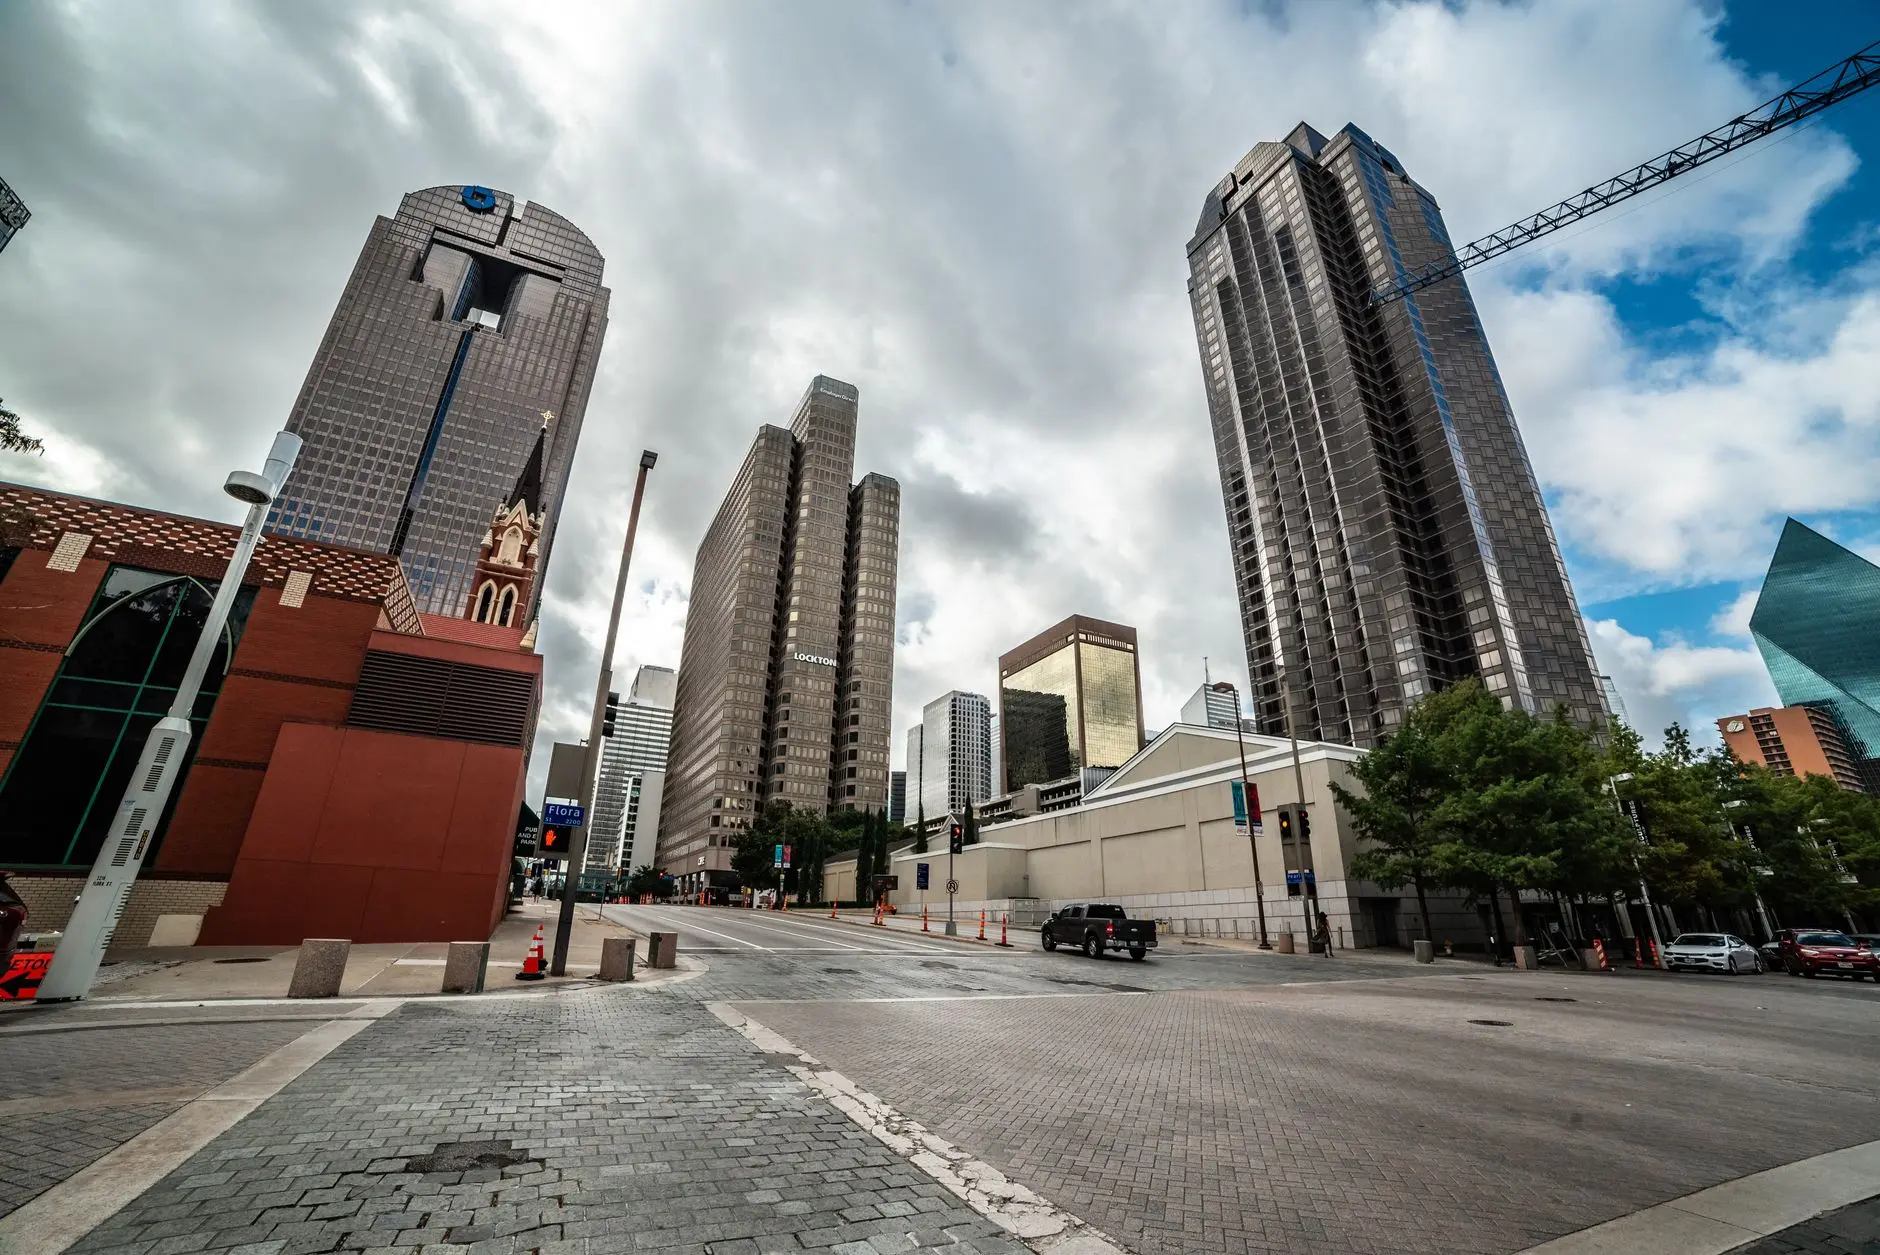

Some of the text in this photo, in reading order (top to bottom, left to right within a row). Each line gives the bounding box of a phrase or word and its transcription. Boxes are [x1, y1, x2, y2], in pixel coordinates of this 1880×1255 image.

[794, 652, 837, 667] LOCKTON
[548, 805, 580, 817] Flora
[10, 958, 52, 971] ETO
